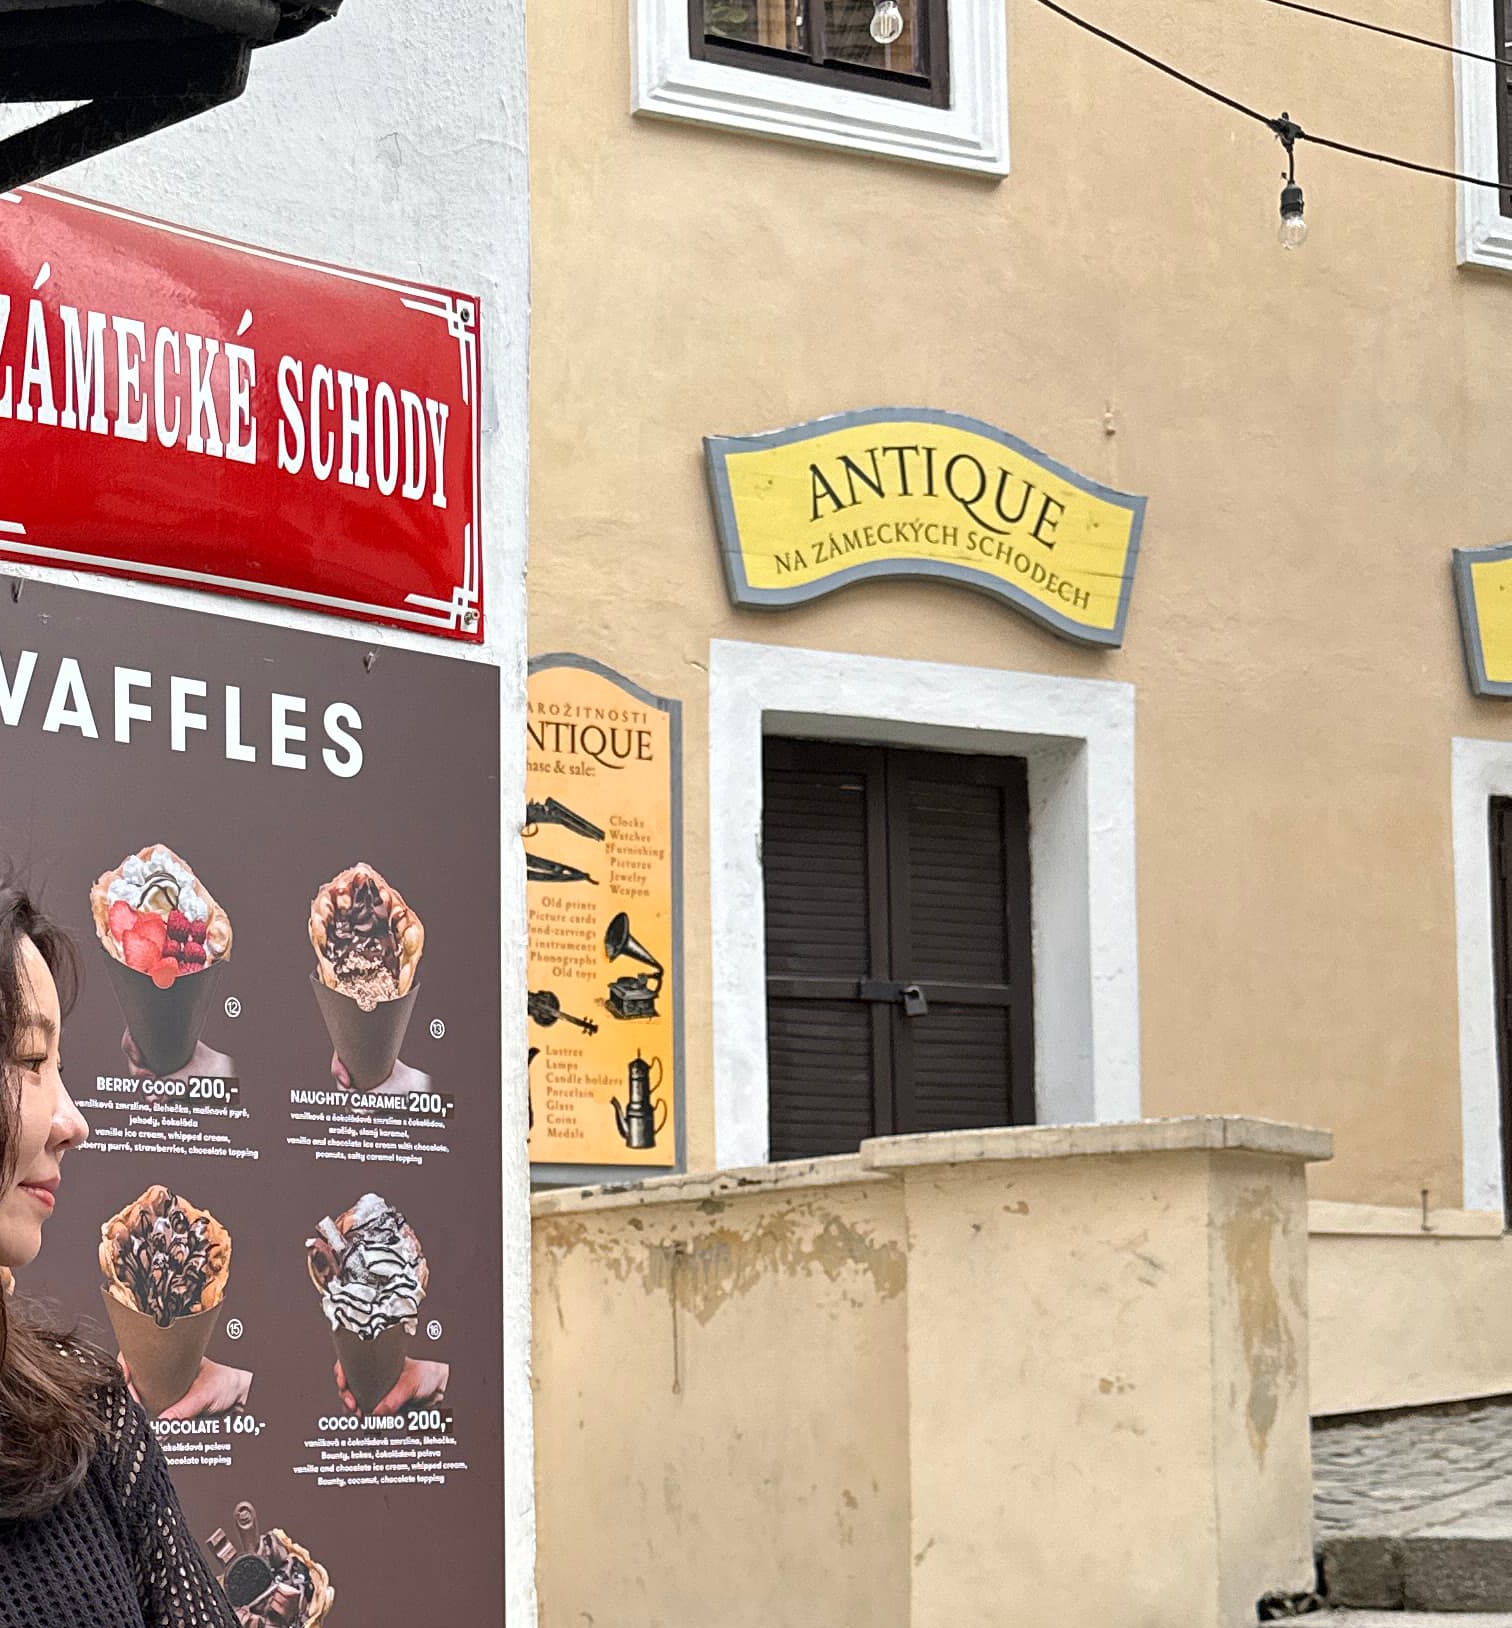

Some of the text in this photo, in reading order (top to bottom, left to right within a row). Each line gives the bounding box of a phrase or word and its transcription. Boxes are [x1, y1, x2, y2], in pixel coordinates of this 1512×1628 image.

[276, 355, 450, 509] SCHODY
[808, 446, 1067, 551] ANTIQUE
[774, 517, 1091, 610] NA ZÁMECKÝCH SCHODECH
[527, 701, 646, 724] AROŽITNOSTI
[527, 720, 653, 769] NTIQUE
[542, 896, 562, 908] Old
[552, 966, 572, 977] Old
[96, 1077, 239, 1103] BERRY GOOD 200,-
[546, 1072, 582, 1084] Candle
[290, 1090, 454, 1117] NAUGHTY CARAMEL 200,-
[150, 1415, 266, 1436] HOCOLATE 160,-
[318, 1411, 452, 1432] COCO JUMBO 200,-
